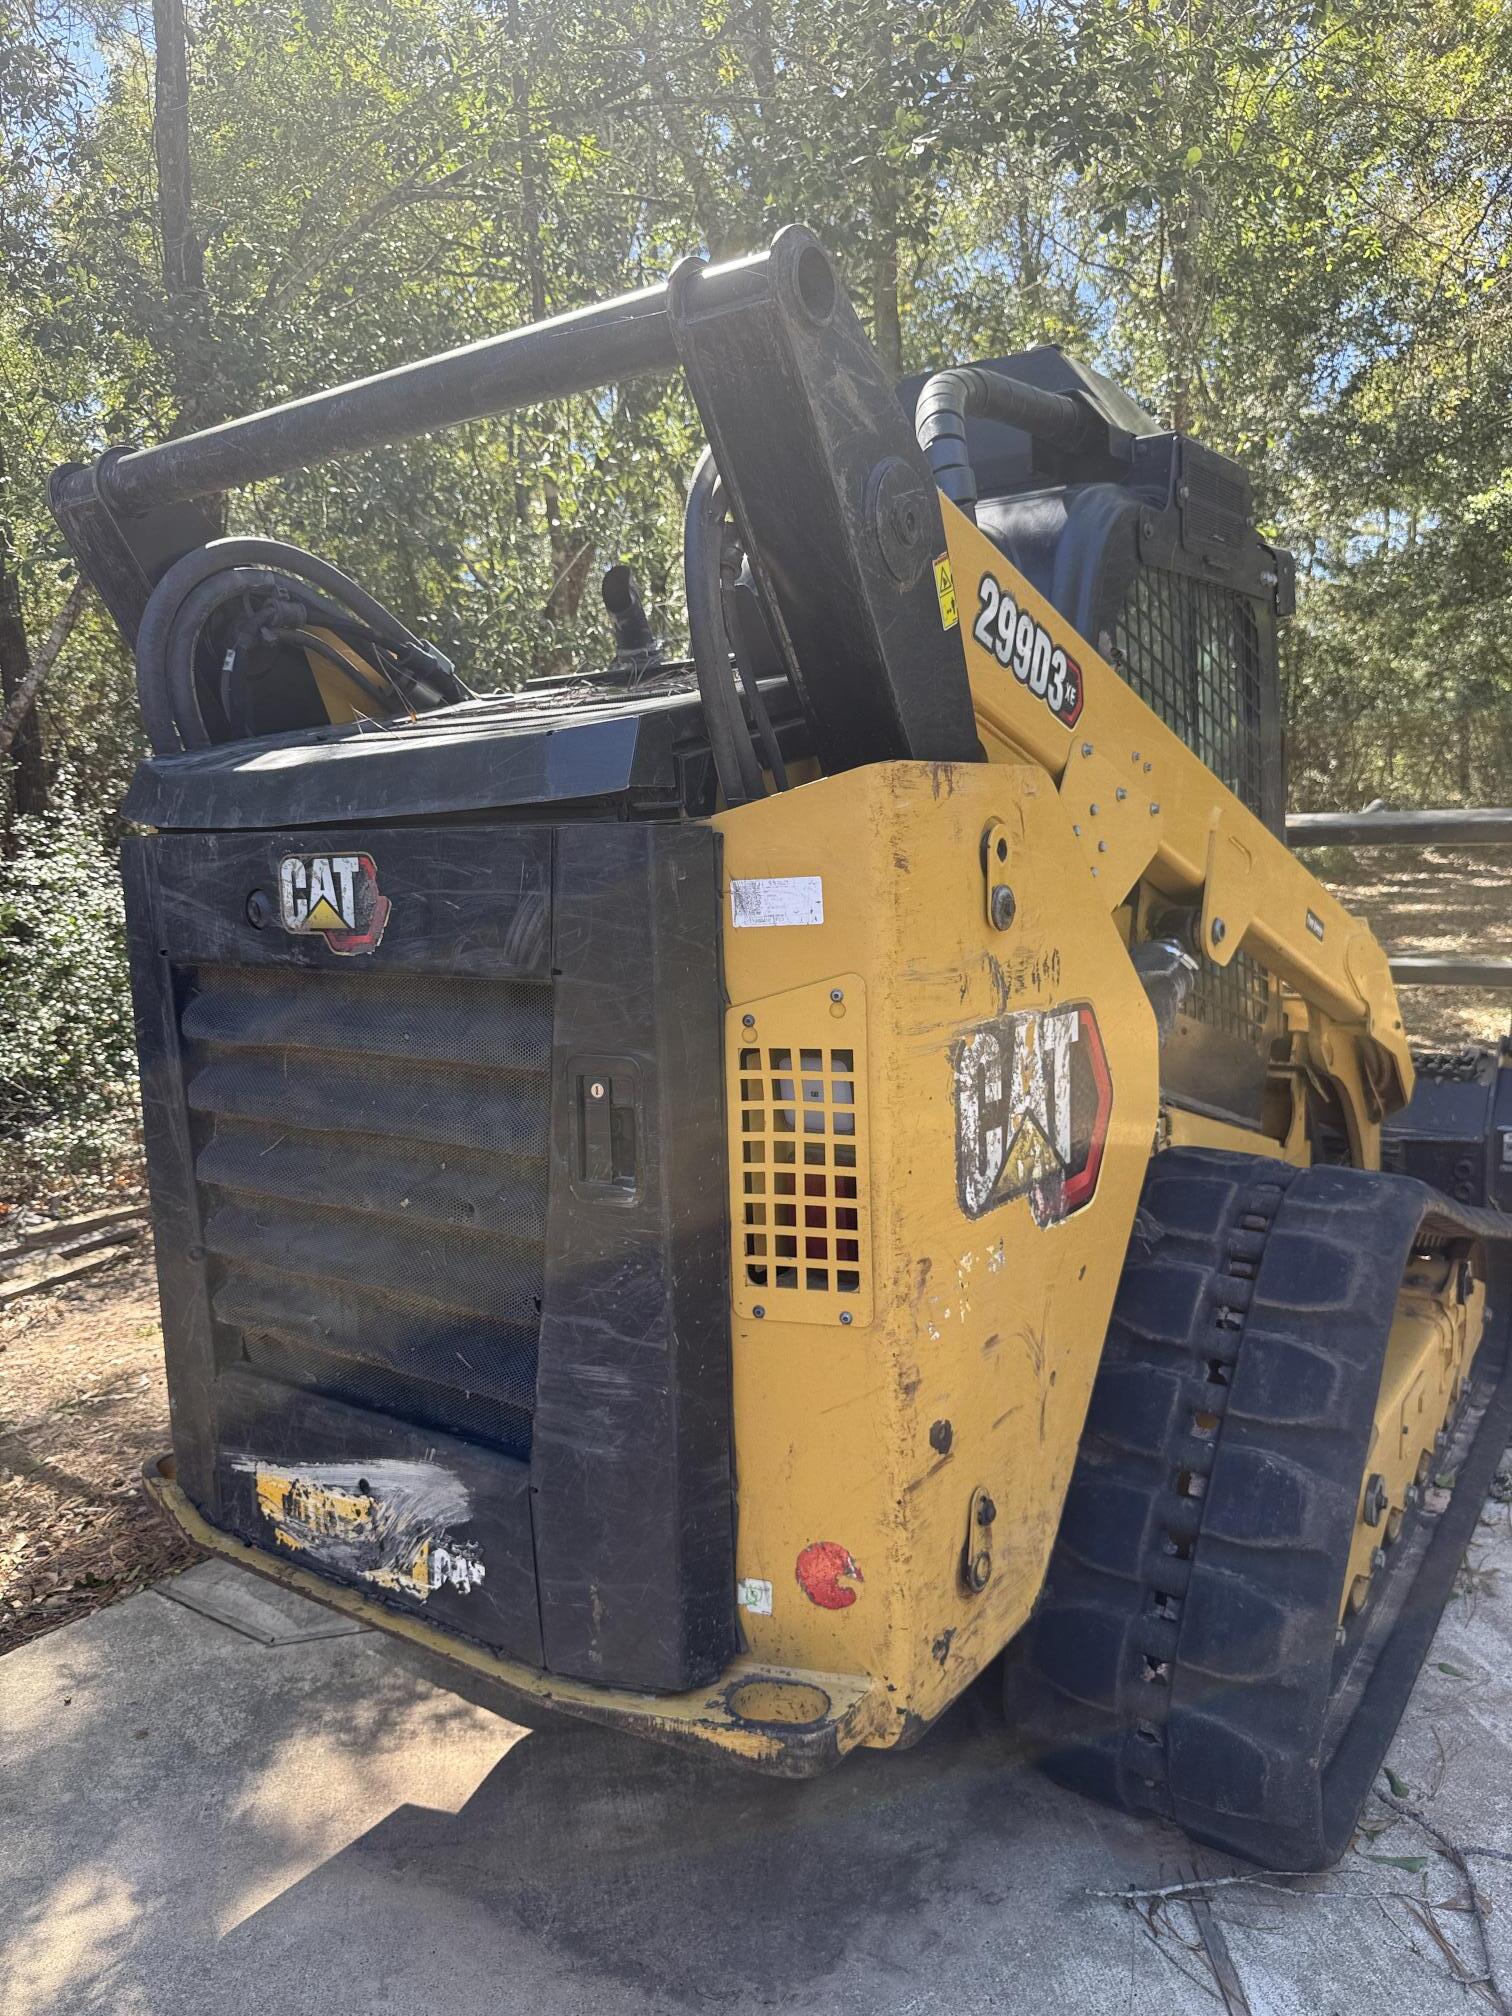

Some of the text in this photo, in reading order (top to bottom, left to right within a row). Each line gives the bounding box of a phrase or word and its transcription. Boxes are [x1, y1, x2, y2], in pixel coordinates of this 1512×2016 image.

[974, 577, 1077, 712] 299D3 XE
[281, 857, 360, 929] CAT
[957, 1010, 1079, 1214] CAT
